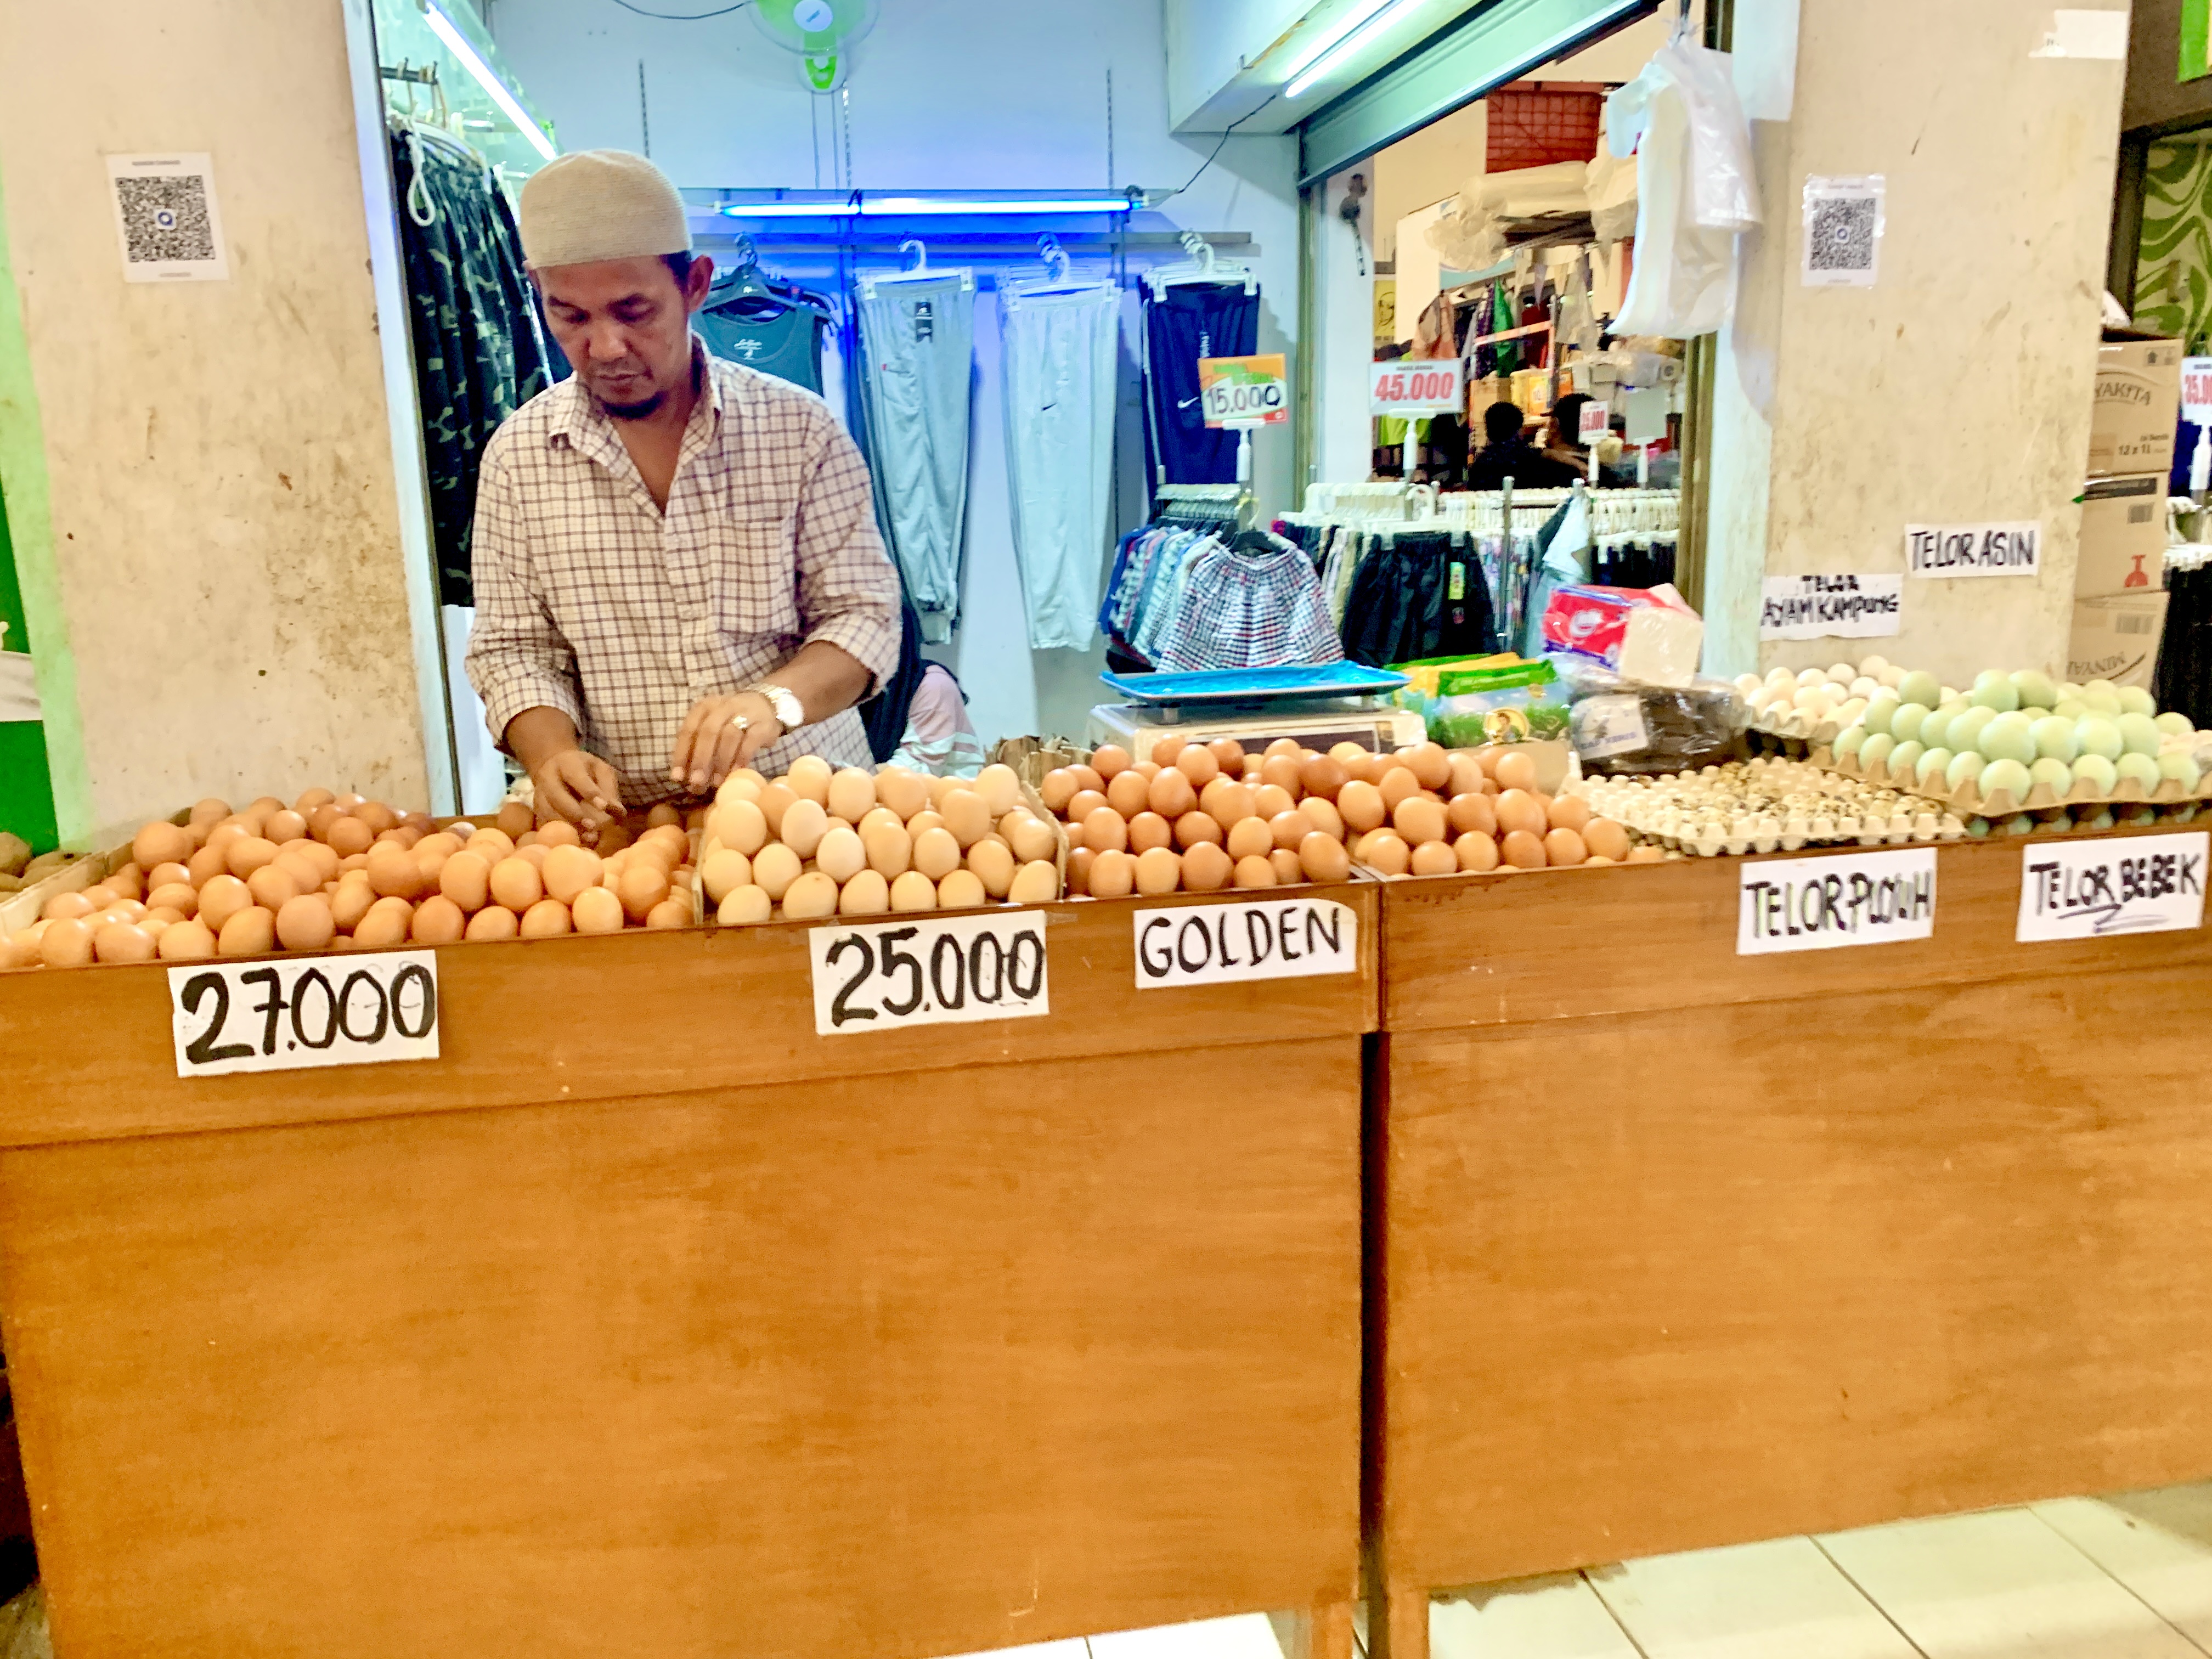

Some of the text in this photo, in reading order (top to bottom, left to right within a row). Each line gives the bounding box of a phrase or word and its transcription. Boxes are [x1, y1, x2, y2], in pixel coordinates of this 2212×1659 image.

[1207, 386, 1280, 415] 15.000
[1374, 372, 1454, 401] 45.000
[1910, 529, 2035, 571] TELOR ASIN
[1742, 873, 1846, 939] TELOR
[2029, 853, 2200, 917] TELOR BEBEK
[1140, 906, 1342, 978] GOLDEN
[825, 926, 1046, 1028] 25.000
[181, 967, 435, 1064] 27.000
